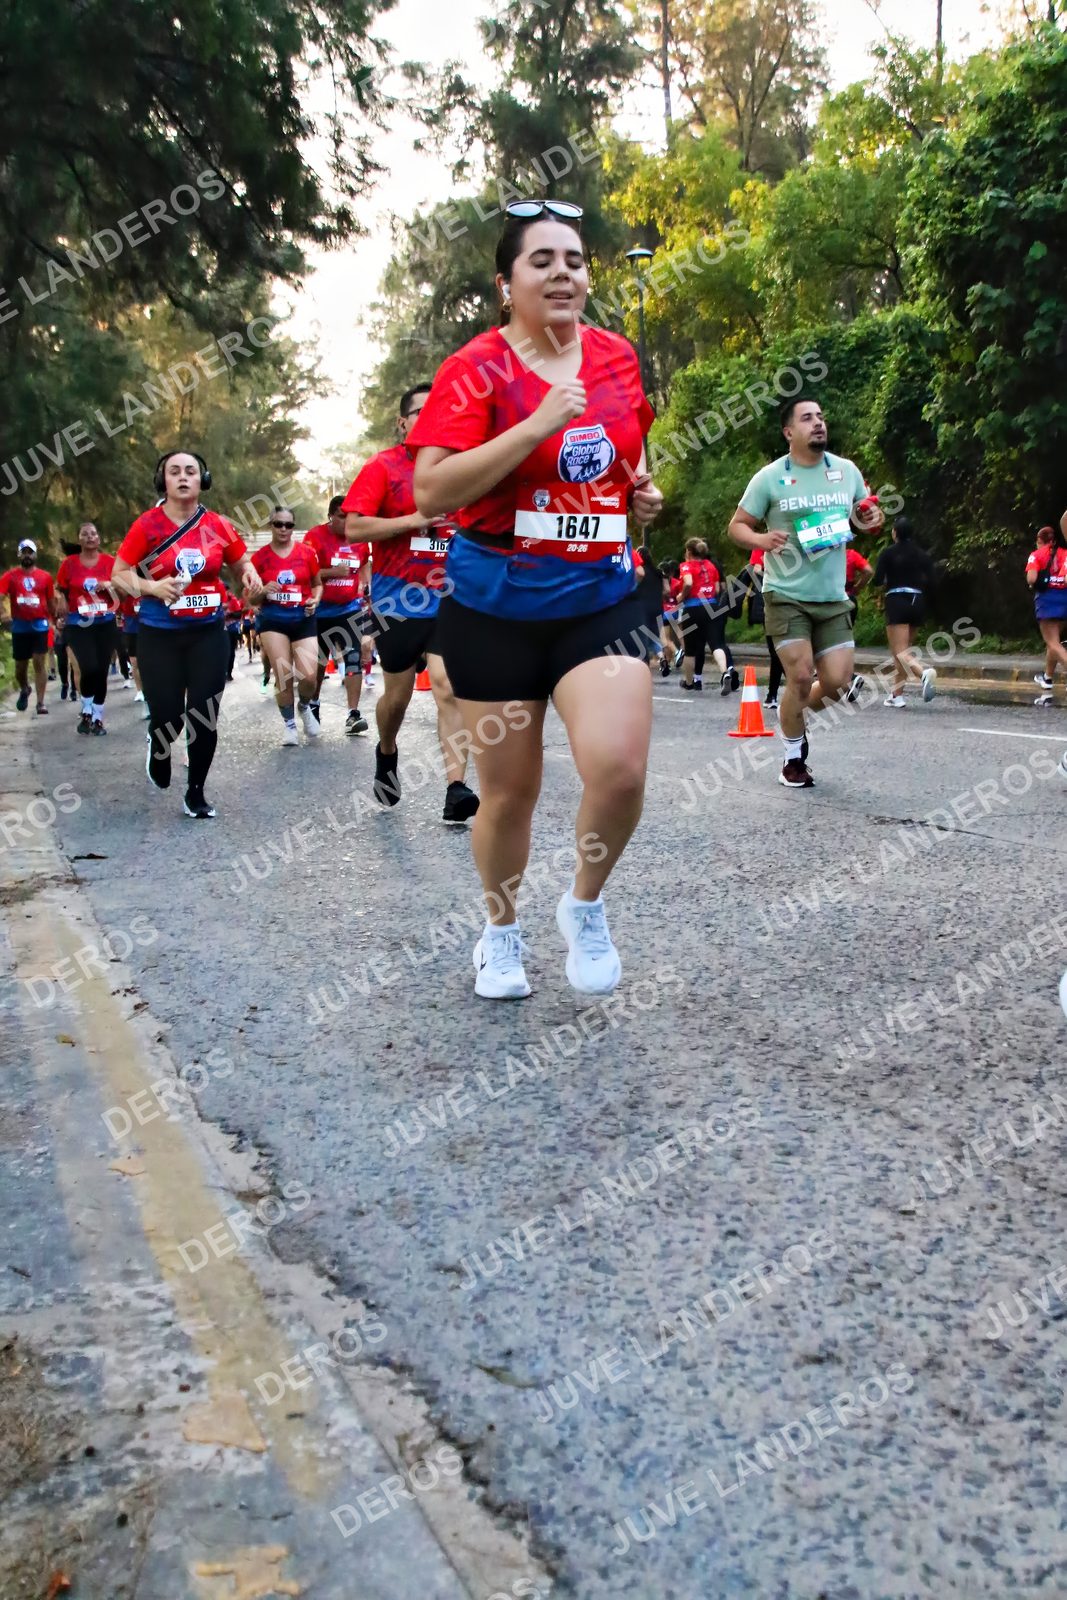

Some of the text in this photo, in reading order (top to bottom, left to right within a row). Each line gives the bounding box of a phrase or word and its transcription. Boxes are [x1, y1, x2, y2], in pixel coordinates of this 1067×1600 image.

[569, 431, 600, 443] BIMBO
[571, 443, 601, 457] Global
[566, 455, 590, 467] Race
[556, 515, 600, 539] 1647
[429, 539, 448, 551] 316
[185, 595, 208, 607] 3623
